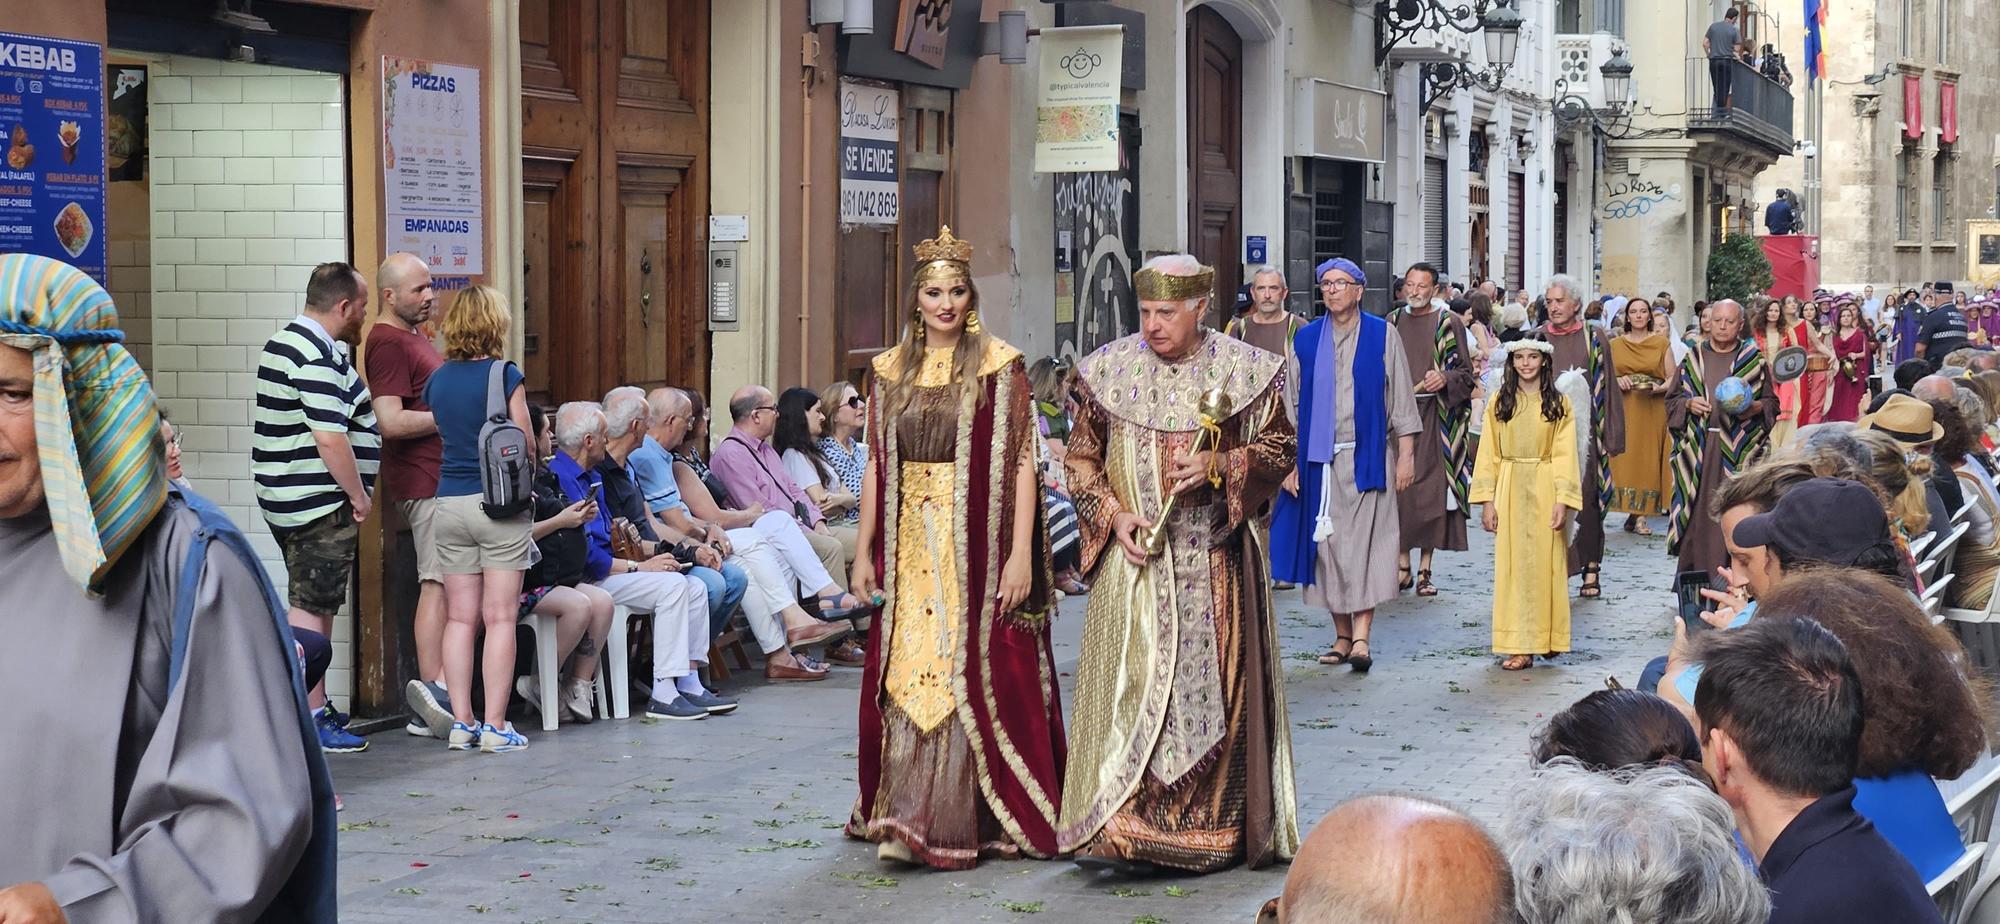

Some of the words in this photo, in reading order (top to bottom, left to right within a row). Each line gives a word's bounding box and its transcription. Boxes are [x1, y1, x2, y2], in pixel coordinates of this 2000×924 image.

[0, 42, 77, 73] KEBAB
[412, 72, 455, 93] PIZZAS
[1049, 81, 1110, 92] @typicalvalencia
[845, 146, 858, 171] SE
[860, 147, 894, 174] VENDE
[9, 171, 35, 181] (FALAFEL)
[842, 190, 856, 217] 961
[858, 191, 876, 217] 042
[877, 192, 897, 218] 869
[405, 219, 469, 233] EMPANADAS
